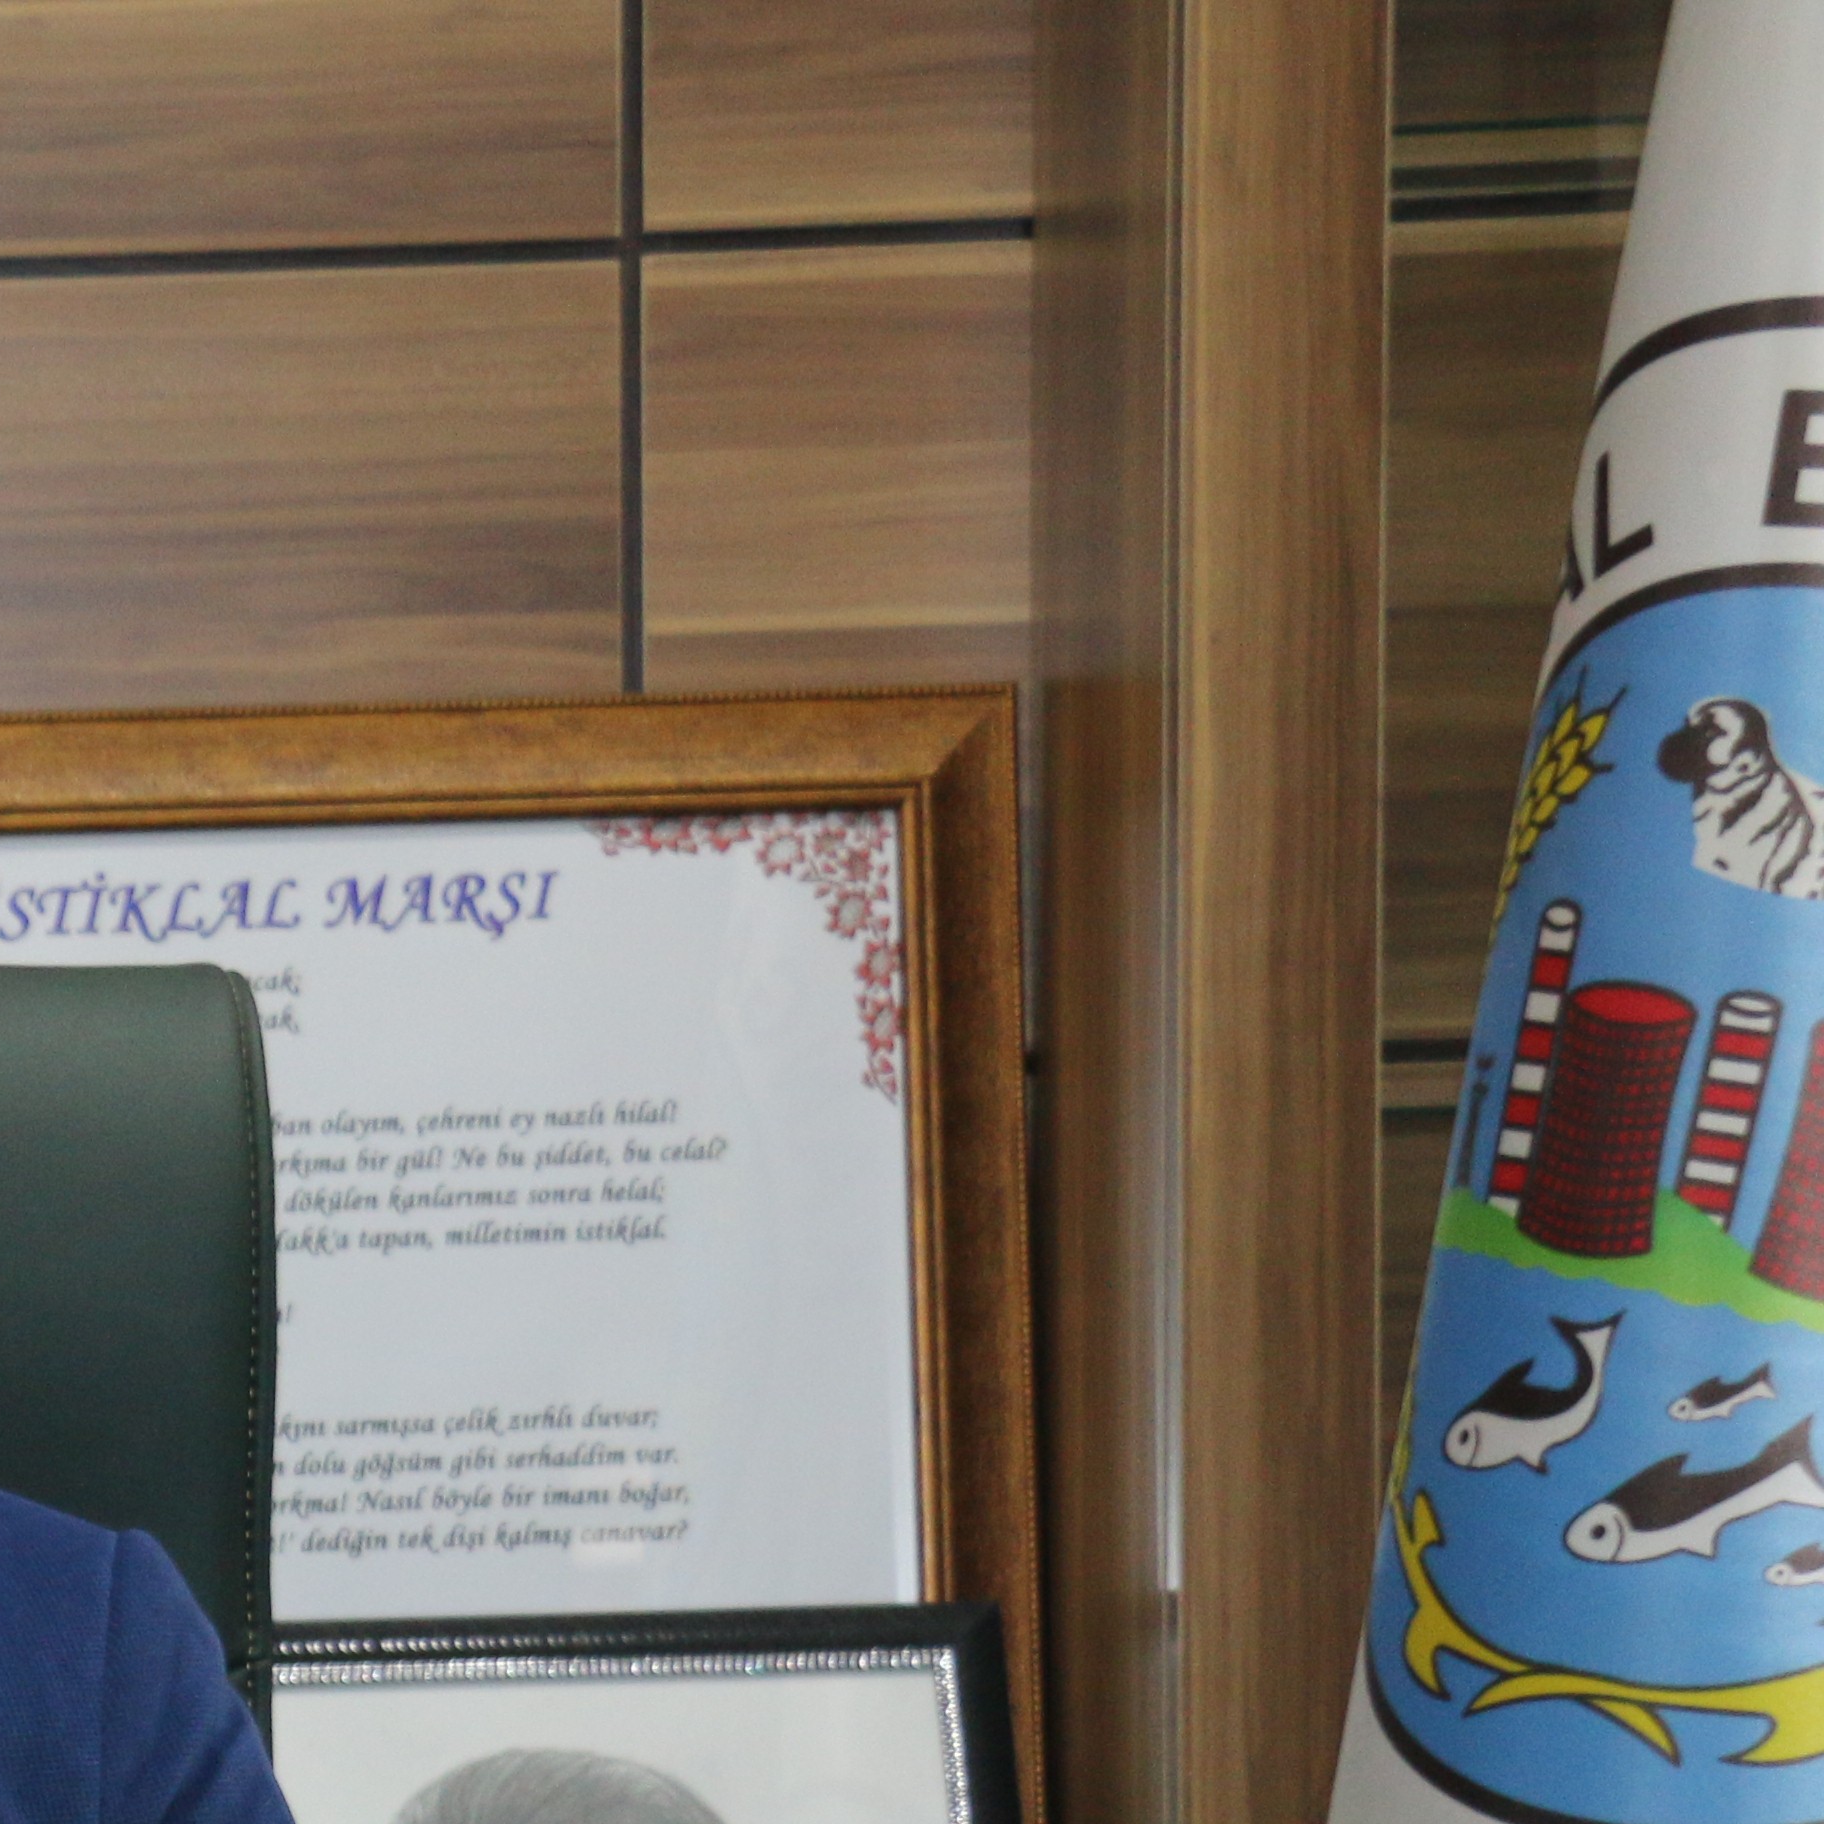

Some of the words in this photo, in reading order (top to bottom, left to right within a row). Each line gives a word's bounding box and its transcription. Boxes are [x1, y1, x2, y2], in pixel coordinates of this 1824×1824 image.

[324, 869, 559, 941] MARŞI
[509, 1112, 535, 1137] ey
[355, 1147, 389, 1172] bir
[453, 1147, 488, 1170] Ne
[496, 1142, 525, 1168] bu
[622, 1138, 651, 1164] bu
[527, 1186, 592, 1206] sonra
[293, 1450, 347, 1477] dolu
[501, 1481, 536, 1508] bir
